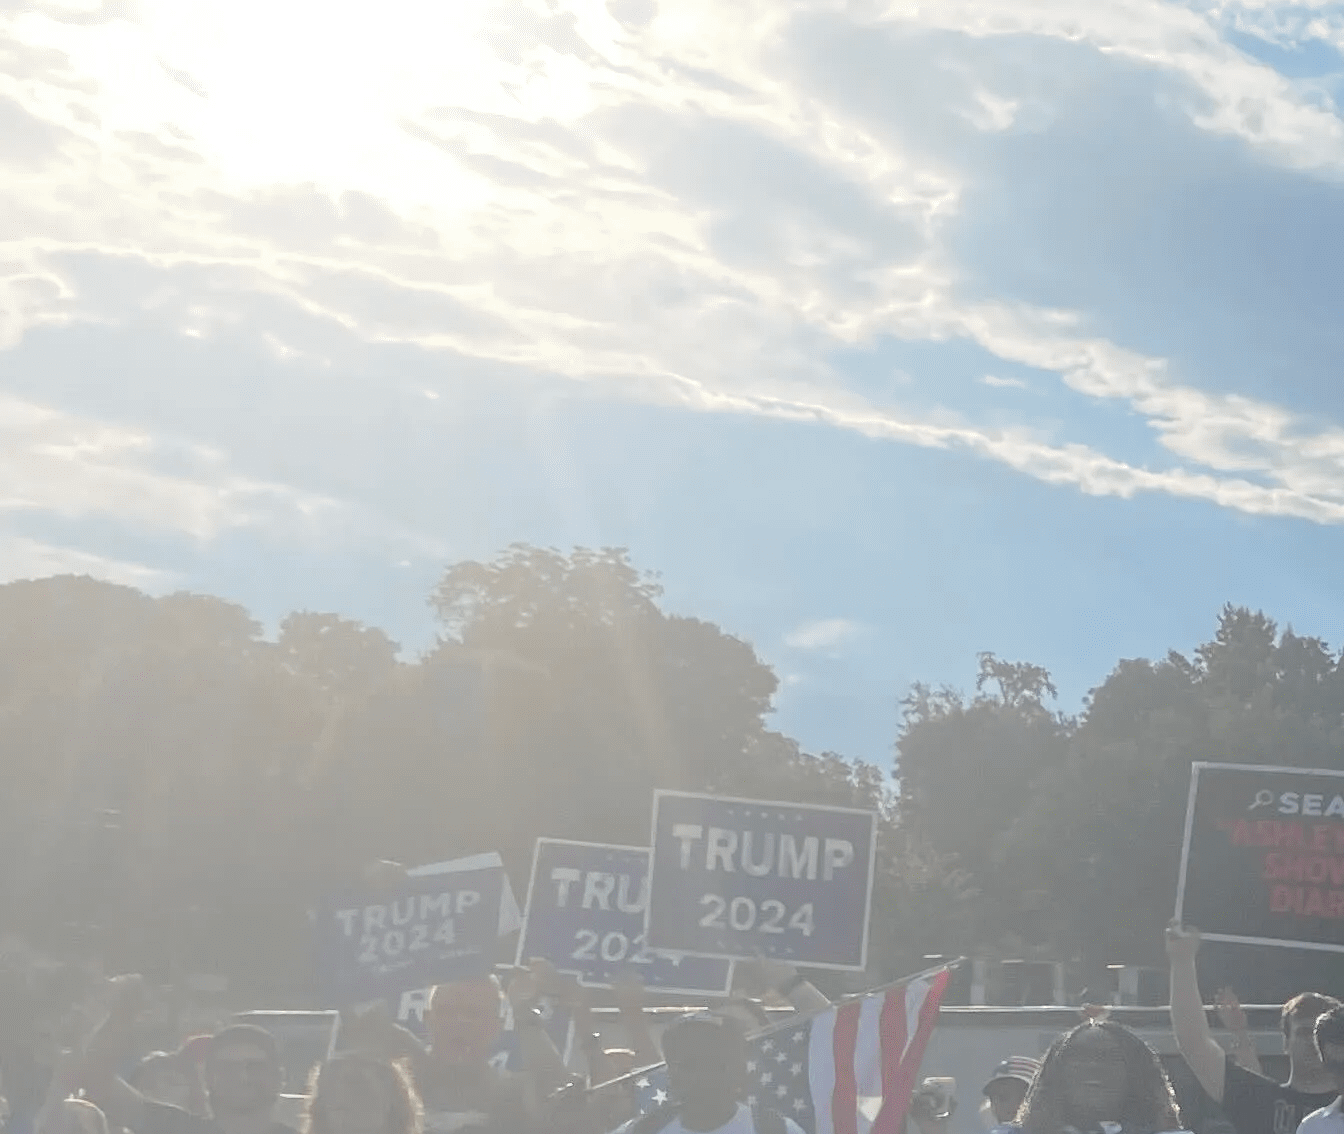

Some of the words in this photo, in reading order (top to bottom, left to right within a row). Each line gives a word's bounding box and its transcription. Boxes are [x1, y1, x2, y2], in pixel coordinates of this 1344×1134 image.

[672, 823, 855, 881] TRUMP
[336, 889, 481, 937] TRUMP
[551, 866, 652, 914] TRU
[699, 893, 816, 937] 2024
[359, 918, 456, 964] 2024
